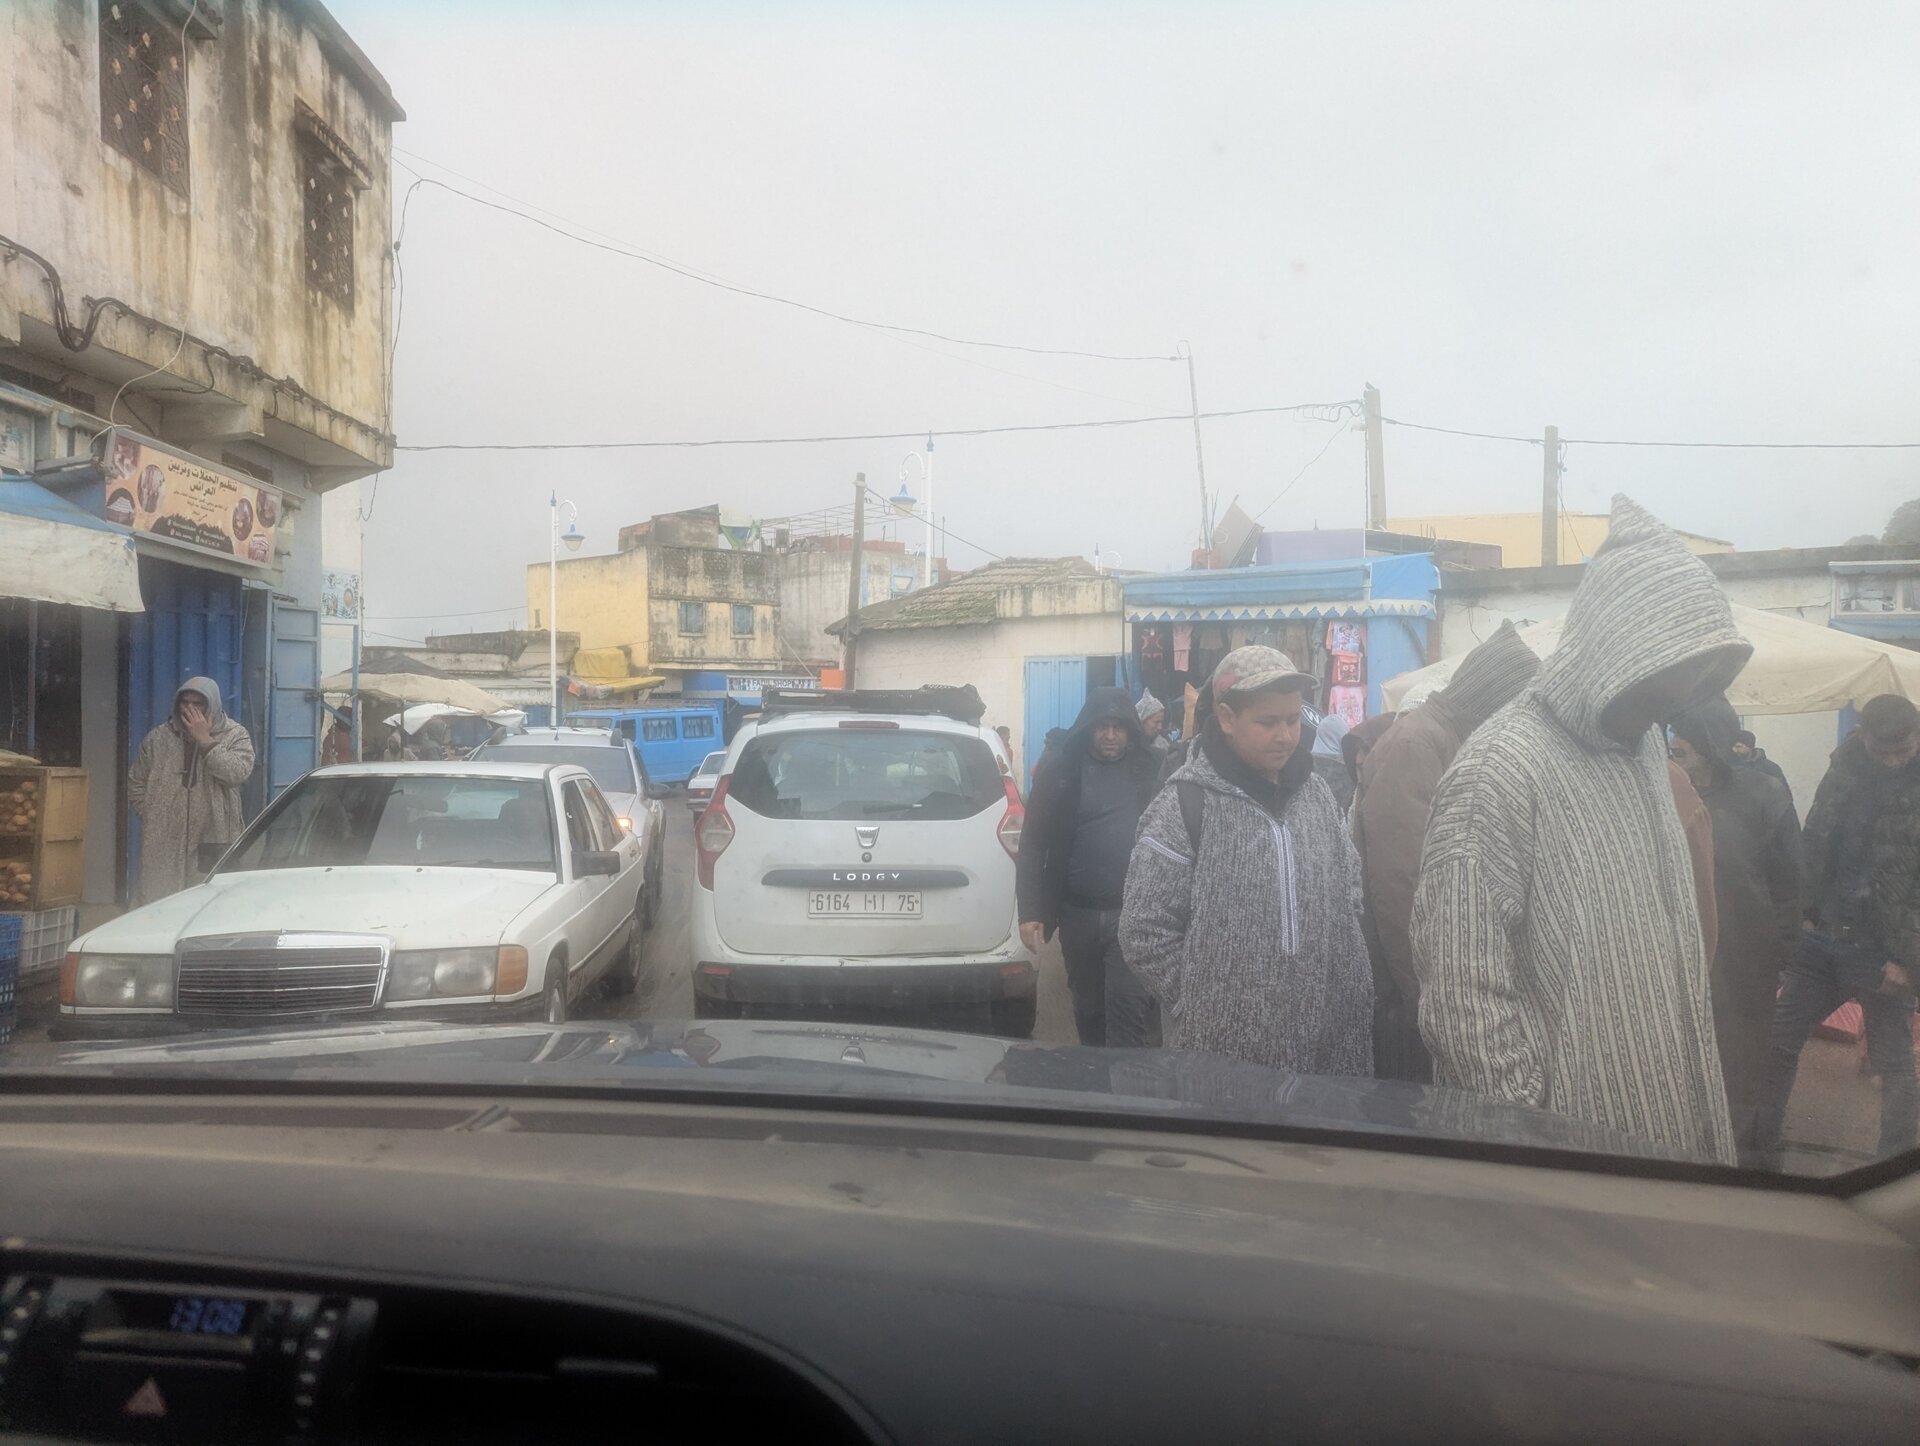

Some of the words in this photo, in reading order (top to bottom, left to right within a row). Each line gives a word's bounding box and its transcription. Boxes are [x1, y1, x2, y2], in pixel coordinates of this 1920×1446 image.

[833, 872, 900, 881] LODGY
[816, 894, 850, 911] 6164
[898, 895, 915, 912] 75
